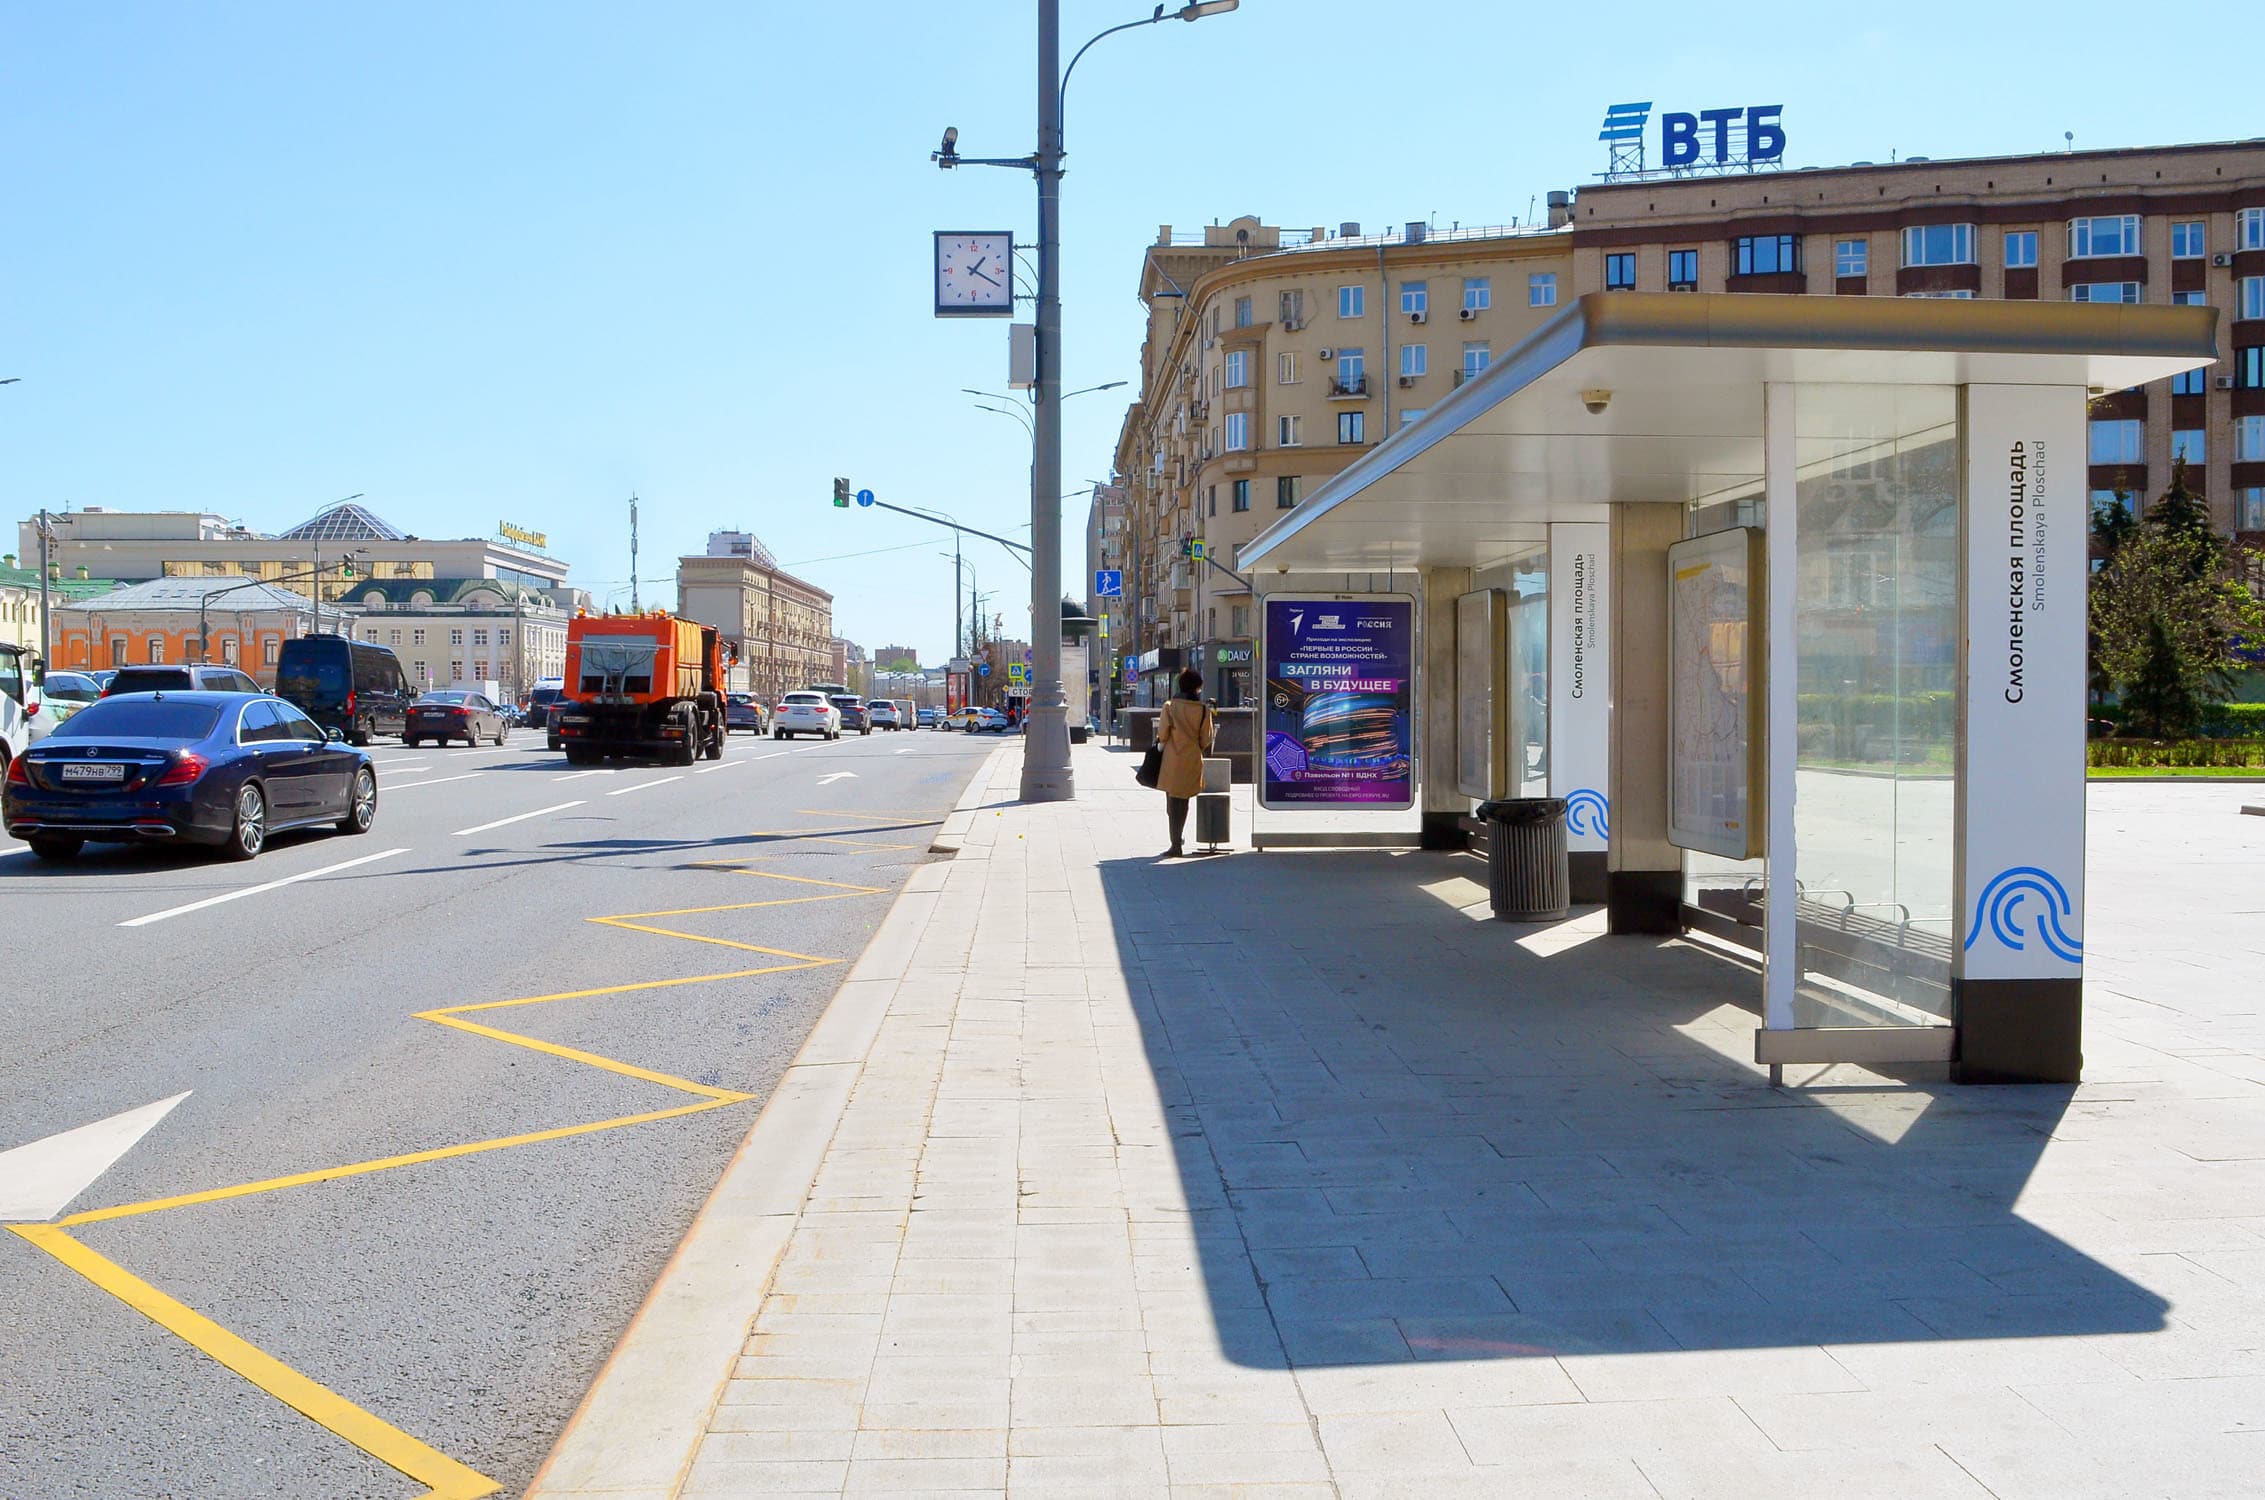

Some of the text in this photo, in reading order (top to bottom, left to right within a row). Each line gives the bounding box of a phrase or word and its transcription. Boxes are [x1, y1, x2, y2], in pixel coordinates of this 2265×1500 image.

[1662, 104, 1786, 166] ВТБ
[2032, 440, 2048, 611] Smolenskaya Ploschad
[1587, 553, 1596, 649] Smolenskaya Ploschad
[2005, 440, 2027, 704] Смоленская площадь
[1228, 650, 1250, 661] DAILY
[1572, 553, 1585, 699] Смоленская площадь
[1287, 665, 1352, 676] ЗАГЛЯНИ
[1311, 681, 1392, 692] В БУДУЩЕЕ
[105, 766, 122, 776] 799
